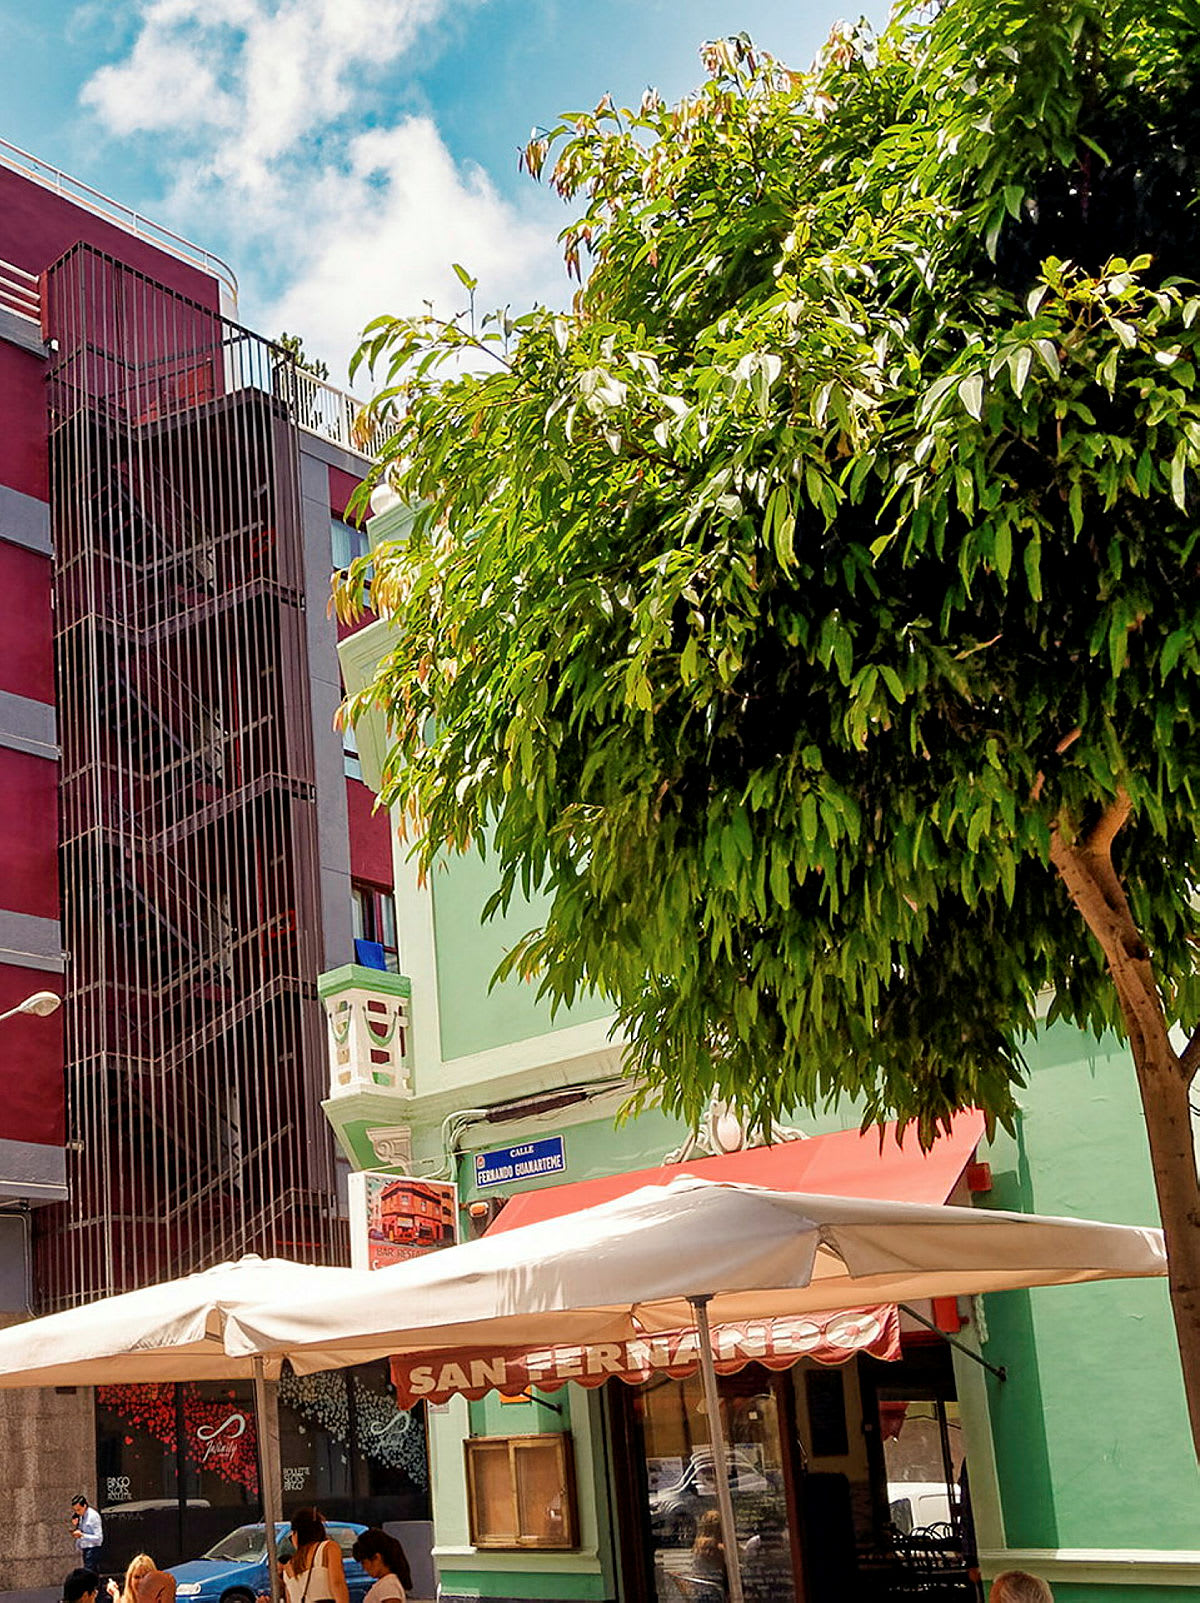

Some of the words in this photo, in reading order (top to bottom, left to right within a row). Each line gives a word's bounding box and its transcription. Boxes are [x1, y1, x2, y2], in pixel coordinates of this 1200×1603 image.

[509, 1145, 535, 1158] CALLE
[477, 1165, 513, 1185] FERNANDO
[514, 1154, 563, 1178] GUANARTEME
[376, 1247, 394, 1258] BAR
[409, 1357, 507, 1395] SAN
[526, 1312, 882, 1382] FERNANDO
